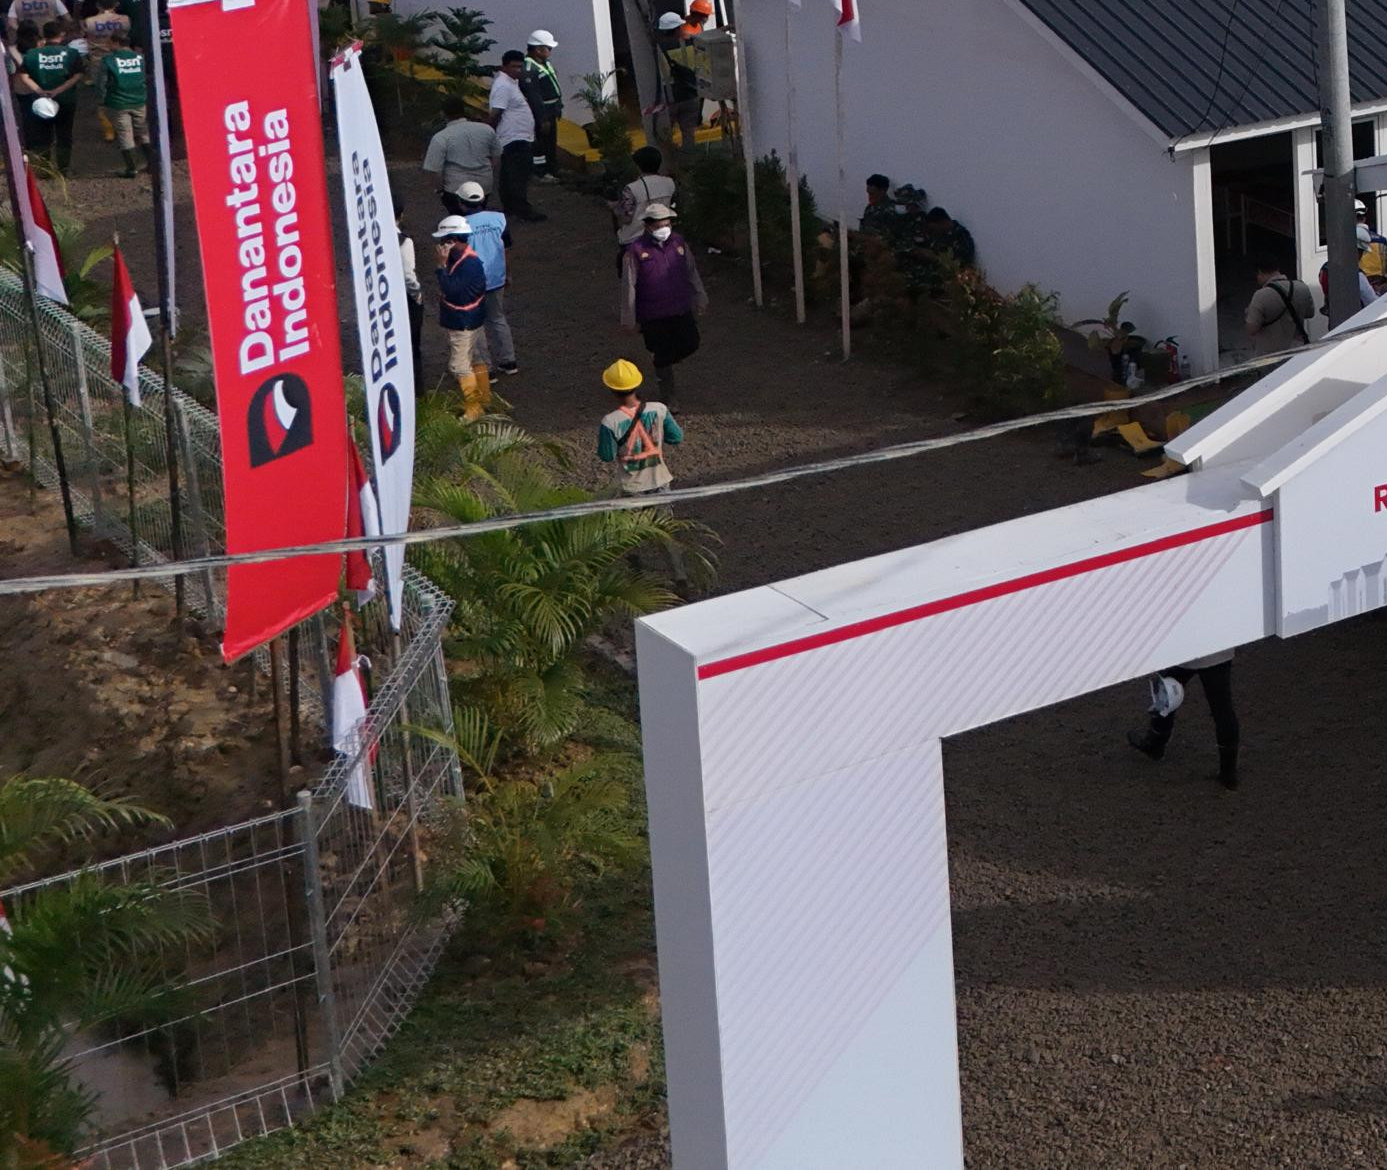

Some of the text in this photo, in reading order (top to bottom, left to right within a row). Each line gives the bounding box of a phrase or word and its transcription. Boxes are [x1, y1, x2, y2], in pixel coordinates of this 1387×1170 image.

[21, 0, 49, 11] btn
[38, 52, 65, 63] bsn
[115, 56, 142, 67] bsn
[224, 100, 275, 375] Danantara
[258, 108, 310, 362] Indonesia
[352, 150, 383, 384] Danantara
[363, 158, 398, 371] Indonesia
